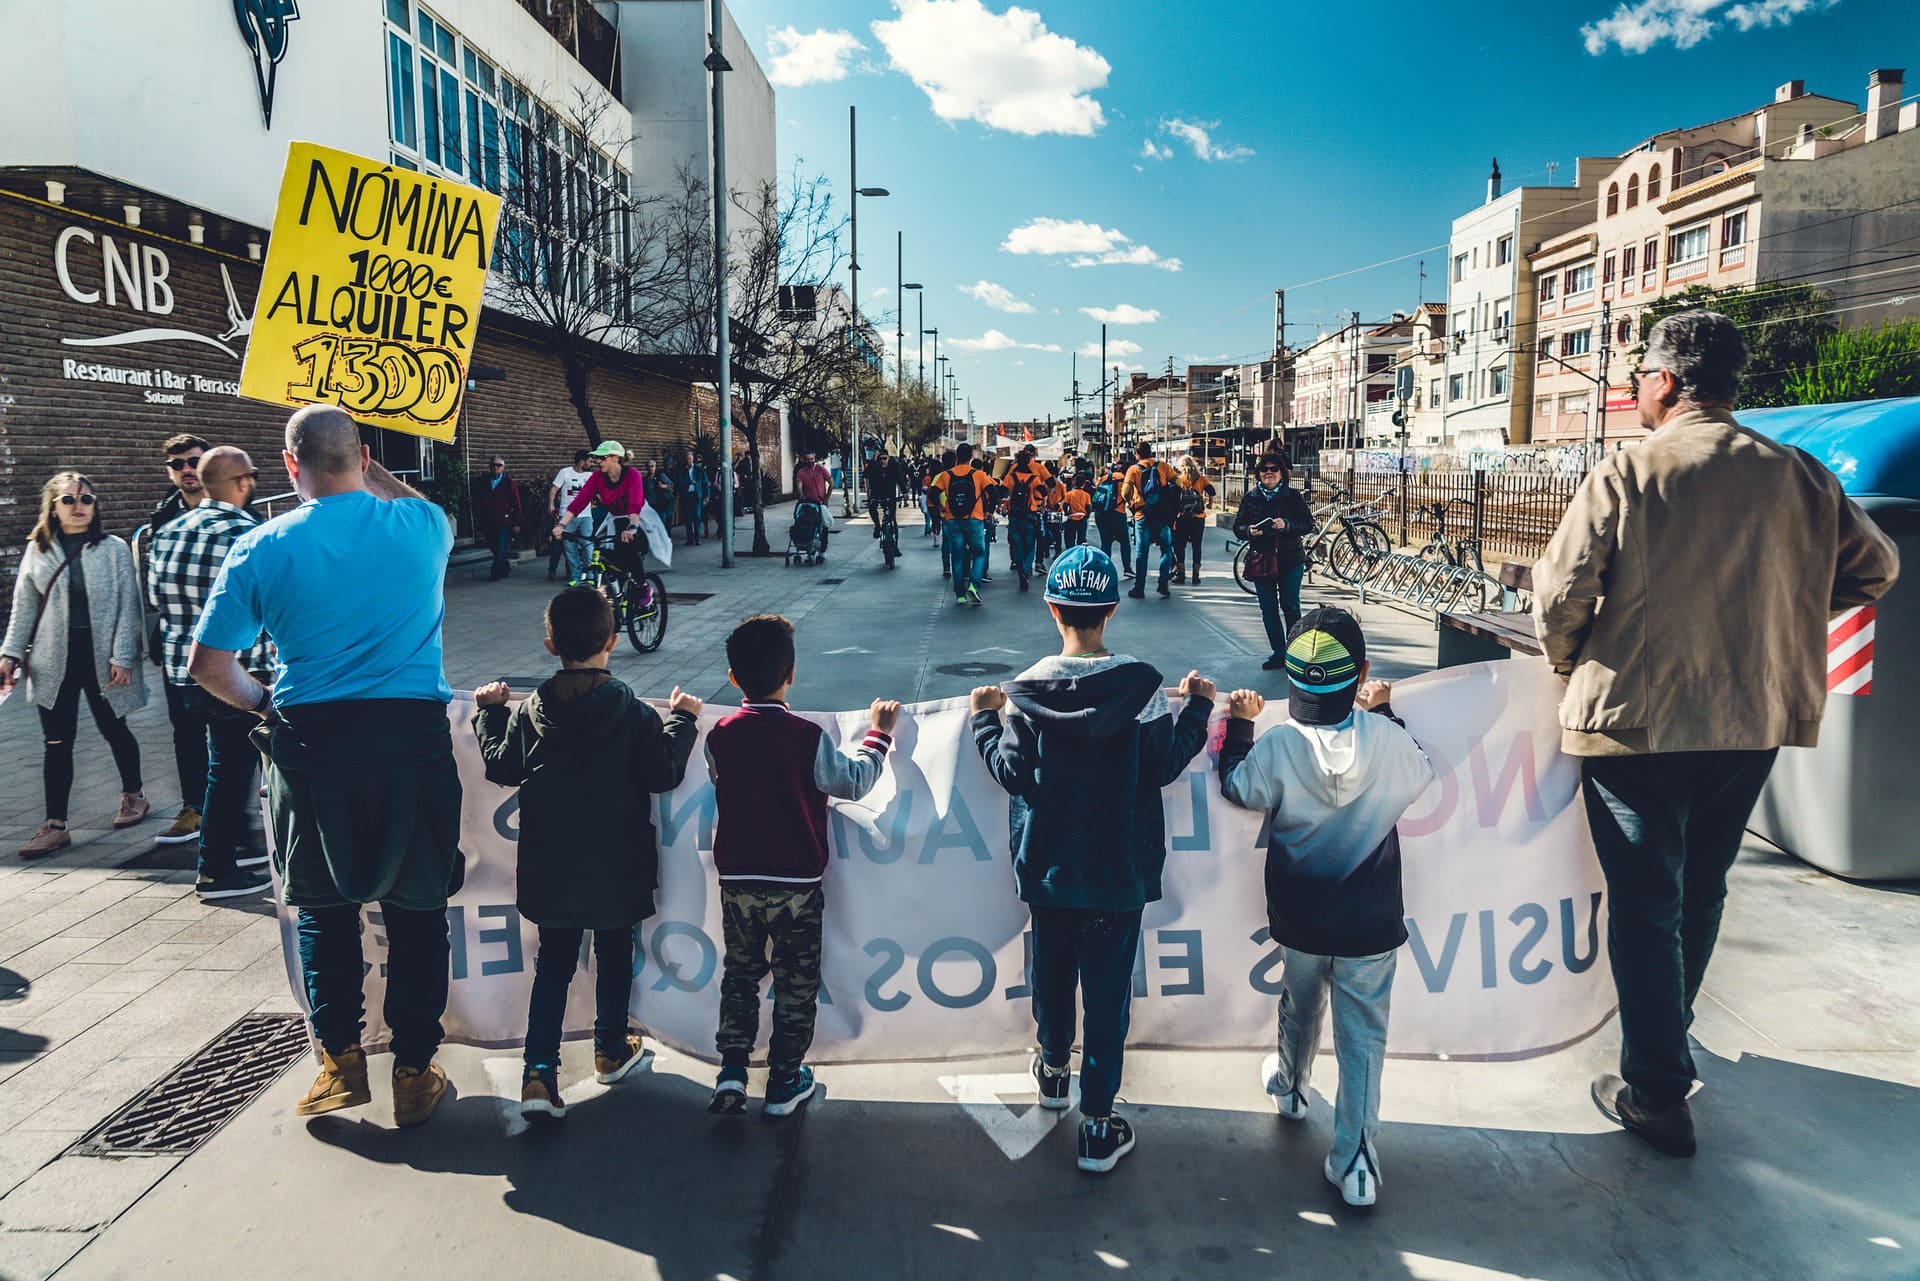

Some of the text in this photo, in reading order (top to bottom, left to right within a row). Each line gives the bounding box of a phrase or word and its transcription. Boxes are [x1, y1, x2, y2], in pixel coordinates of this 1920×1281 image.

[55, 226, 174, 315] CNB
[348, 249, 453, 300] 1000€
[267, 271, 469, 349] ALQUILER
[63, 358, 240, 397] Restaurant i Bar-Terrass
[144, 390, 184, 405] Sotavent
[287, 332, 465, 425] 1300
[1055, 569, 1110, 593] SAN FRAN
